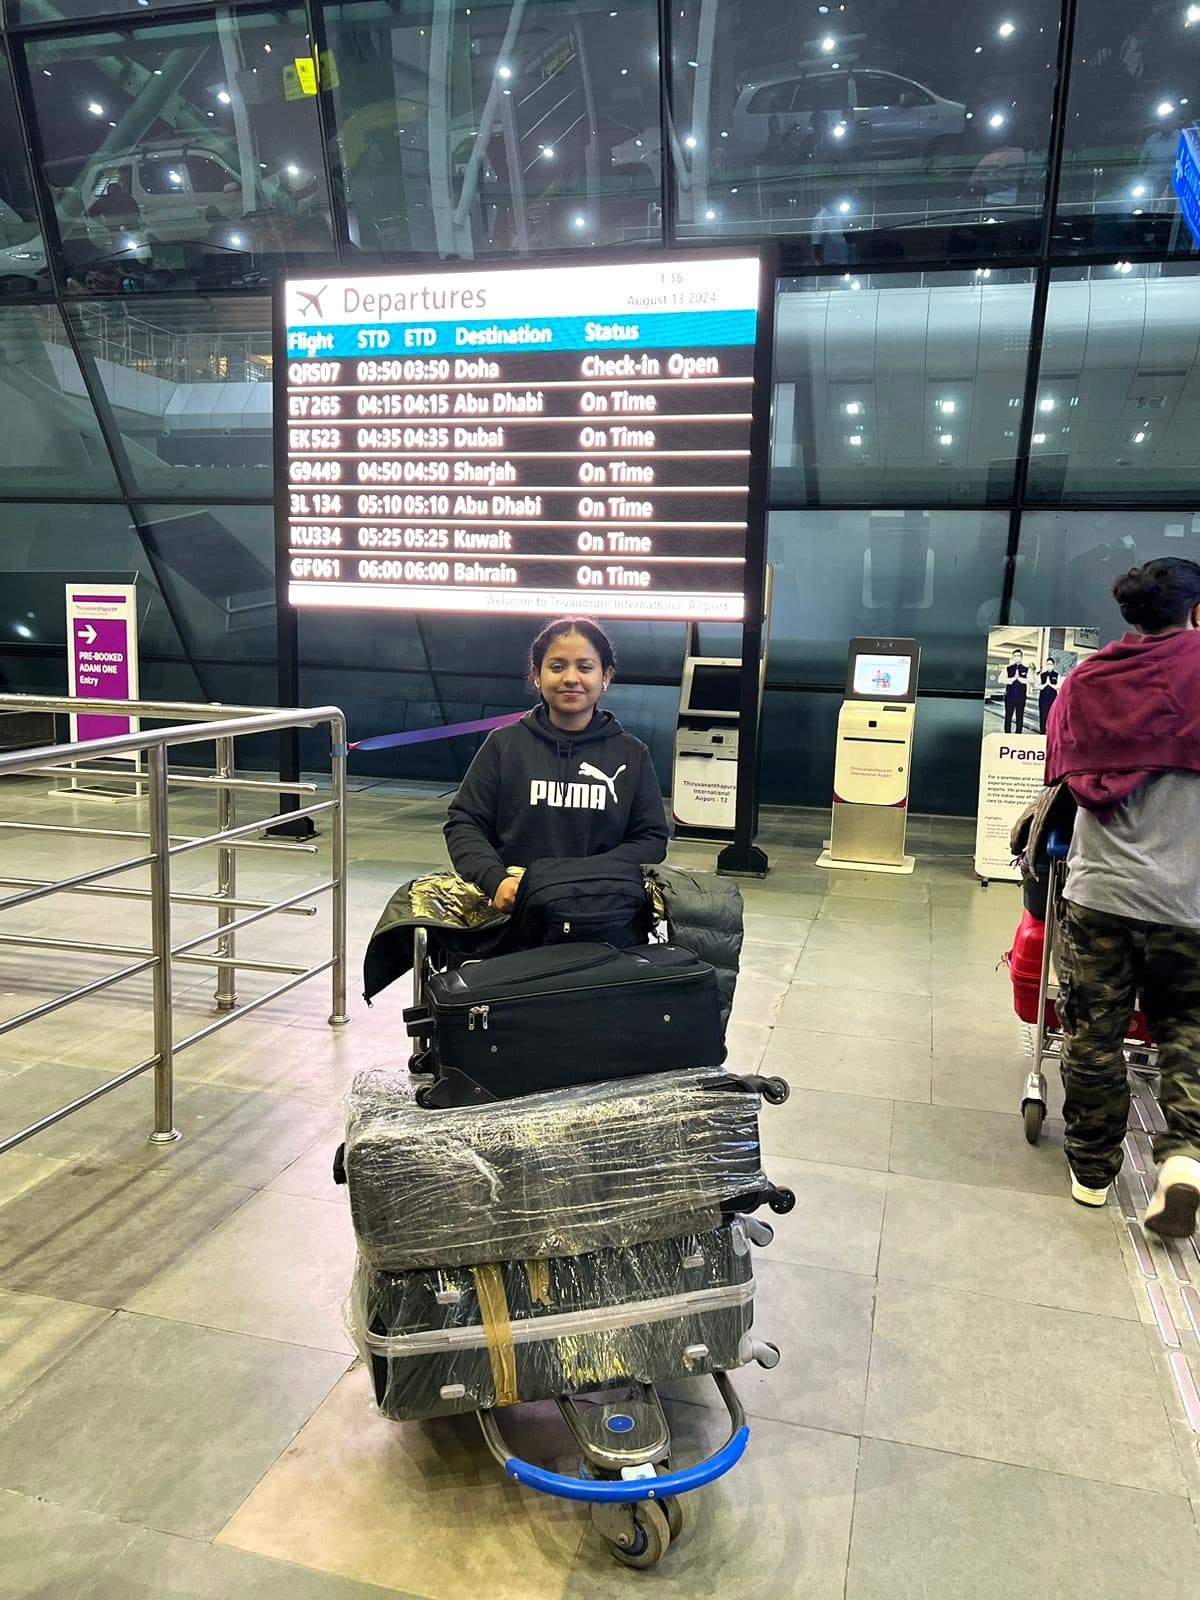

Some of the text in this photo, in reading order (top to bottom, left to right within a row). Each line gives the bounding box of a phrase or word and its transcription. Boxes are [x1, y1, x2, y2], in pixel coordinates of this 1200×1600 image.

[343, 287, 487, 320] Departures
[627, 295, 668, 309] August
[688, 291, 717, 304] 2024
[287, 321, 640, 357] Flight STD ETD Destination Status
[288, 353, 719, 384] QR507 03:50 03:50 Doha Check-in Open
[357, 395, 402, 416] 04:15
[403, 394, 449, 415] 04:15
[453, 393, 490, 414] Abu
[492, 391, 545, 413] Dhabi
[580, 391, 609, 412] On
[610, 390, 657, 411] Time
[357, 428, 402, 448] 04:35
[403, 428, 450, 448] 04:35
[453, 426, 504, 447] Dubai
[579, 427, 607, 447] On
[608, 426, 656, 447] Time
[289, 461, 655, 486] G9449 04:50 04:50 Sharjah On Time
[312, 494, 342, 514] 134
[357, 494, 402, 515] 05:10
[403, 495, 450, 515] 05:10
[453, 495, 489, 515] Abu
[491, 495, 543, 516] Dhabi
[577, 496, 605, 517] On
[607, 496, 654, 517] Time
[290, 526, 652, 551] KU334 05:25 05:25 Kuwait On Time
[290, 558, 651, 586] GF061 06:00 06:00 Bahrain On Time
[485, 594, 532, 607] Welcome
[535, 597, 548, 607] to
[687, 599, 729, 613] Airport
[79, 651, 124, 662] PRE-BOOKED
[79, 663, 118, 674] ADANI ONE
[79, 675, 99, 687] Entry
[1000, 746, 1045, 761] Prana
[529, 779, 607, 811] PUMA
